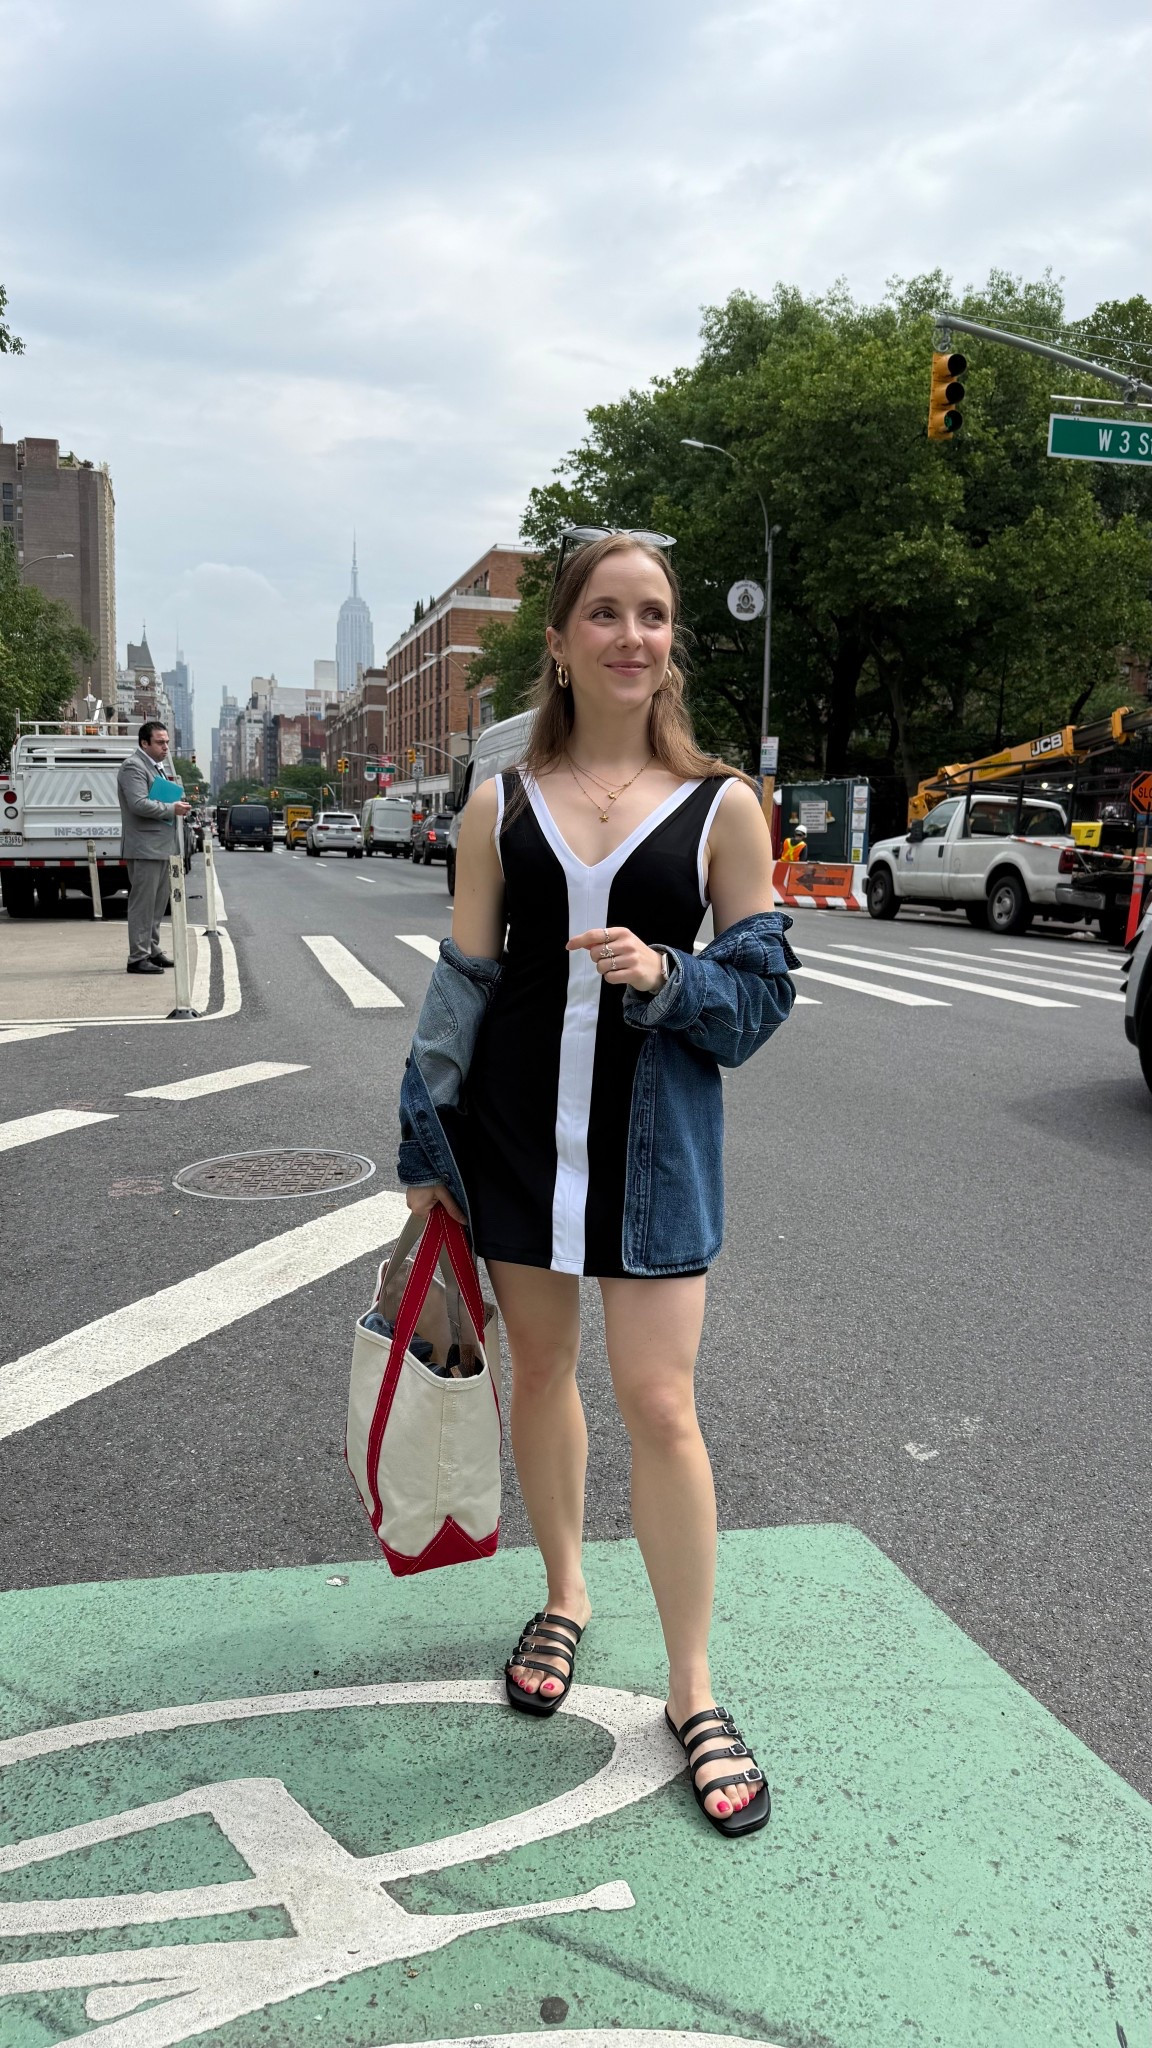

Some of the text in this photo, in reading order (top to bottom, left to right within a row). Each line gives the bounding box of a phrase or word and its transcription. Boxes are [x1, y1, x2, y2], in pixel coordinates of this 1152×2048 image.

[1098, 428, 1152, 455] W 3 S
[1031, 733, 1063, 756] JCB
